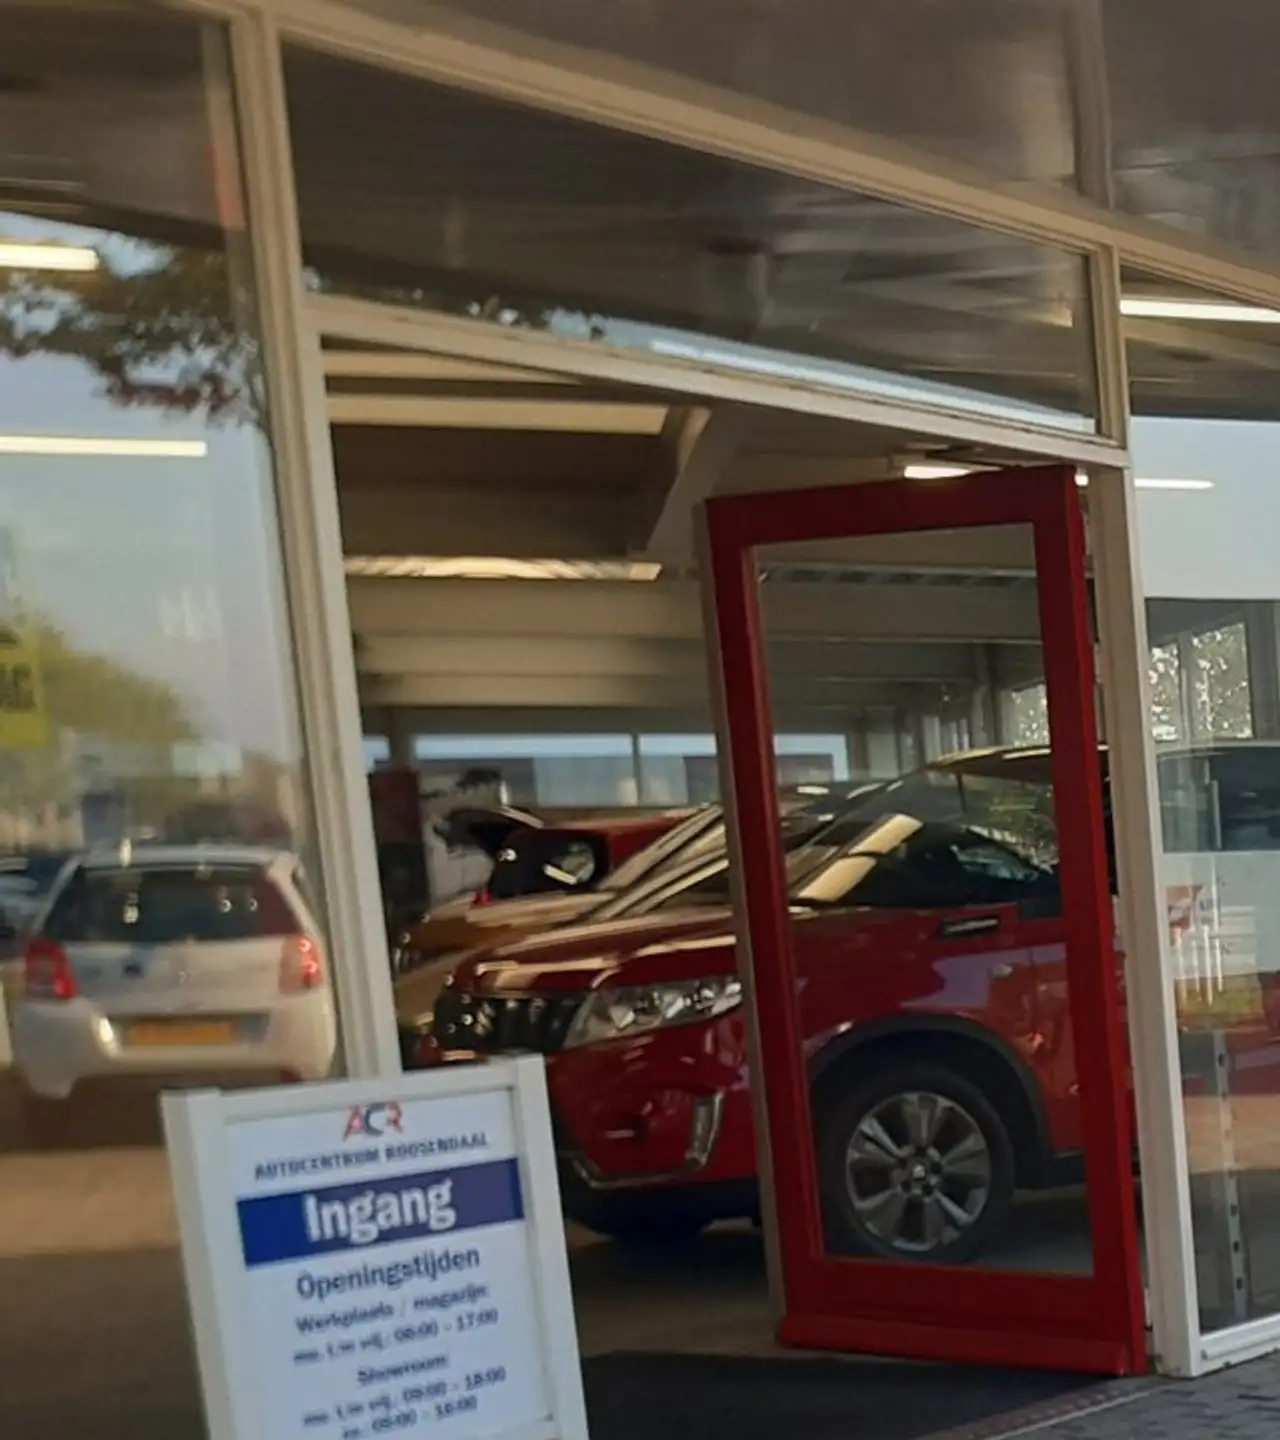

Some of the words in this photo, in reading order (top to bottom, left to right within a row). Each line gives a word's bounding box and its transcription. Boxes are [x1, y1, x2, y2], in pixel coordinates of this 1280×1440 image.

[343, 1100, 405, 1142] ACR
[254, 1146, 382, 1182] AUTOCENTRUM
[384, 1130, 489, 1164] ROOSENDAAL
[304, 1177, 458, 1245] Ingang
[296, 1247, 481, 1300] Openingstijden
